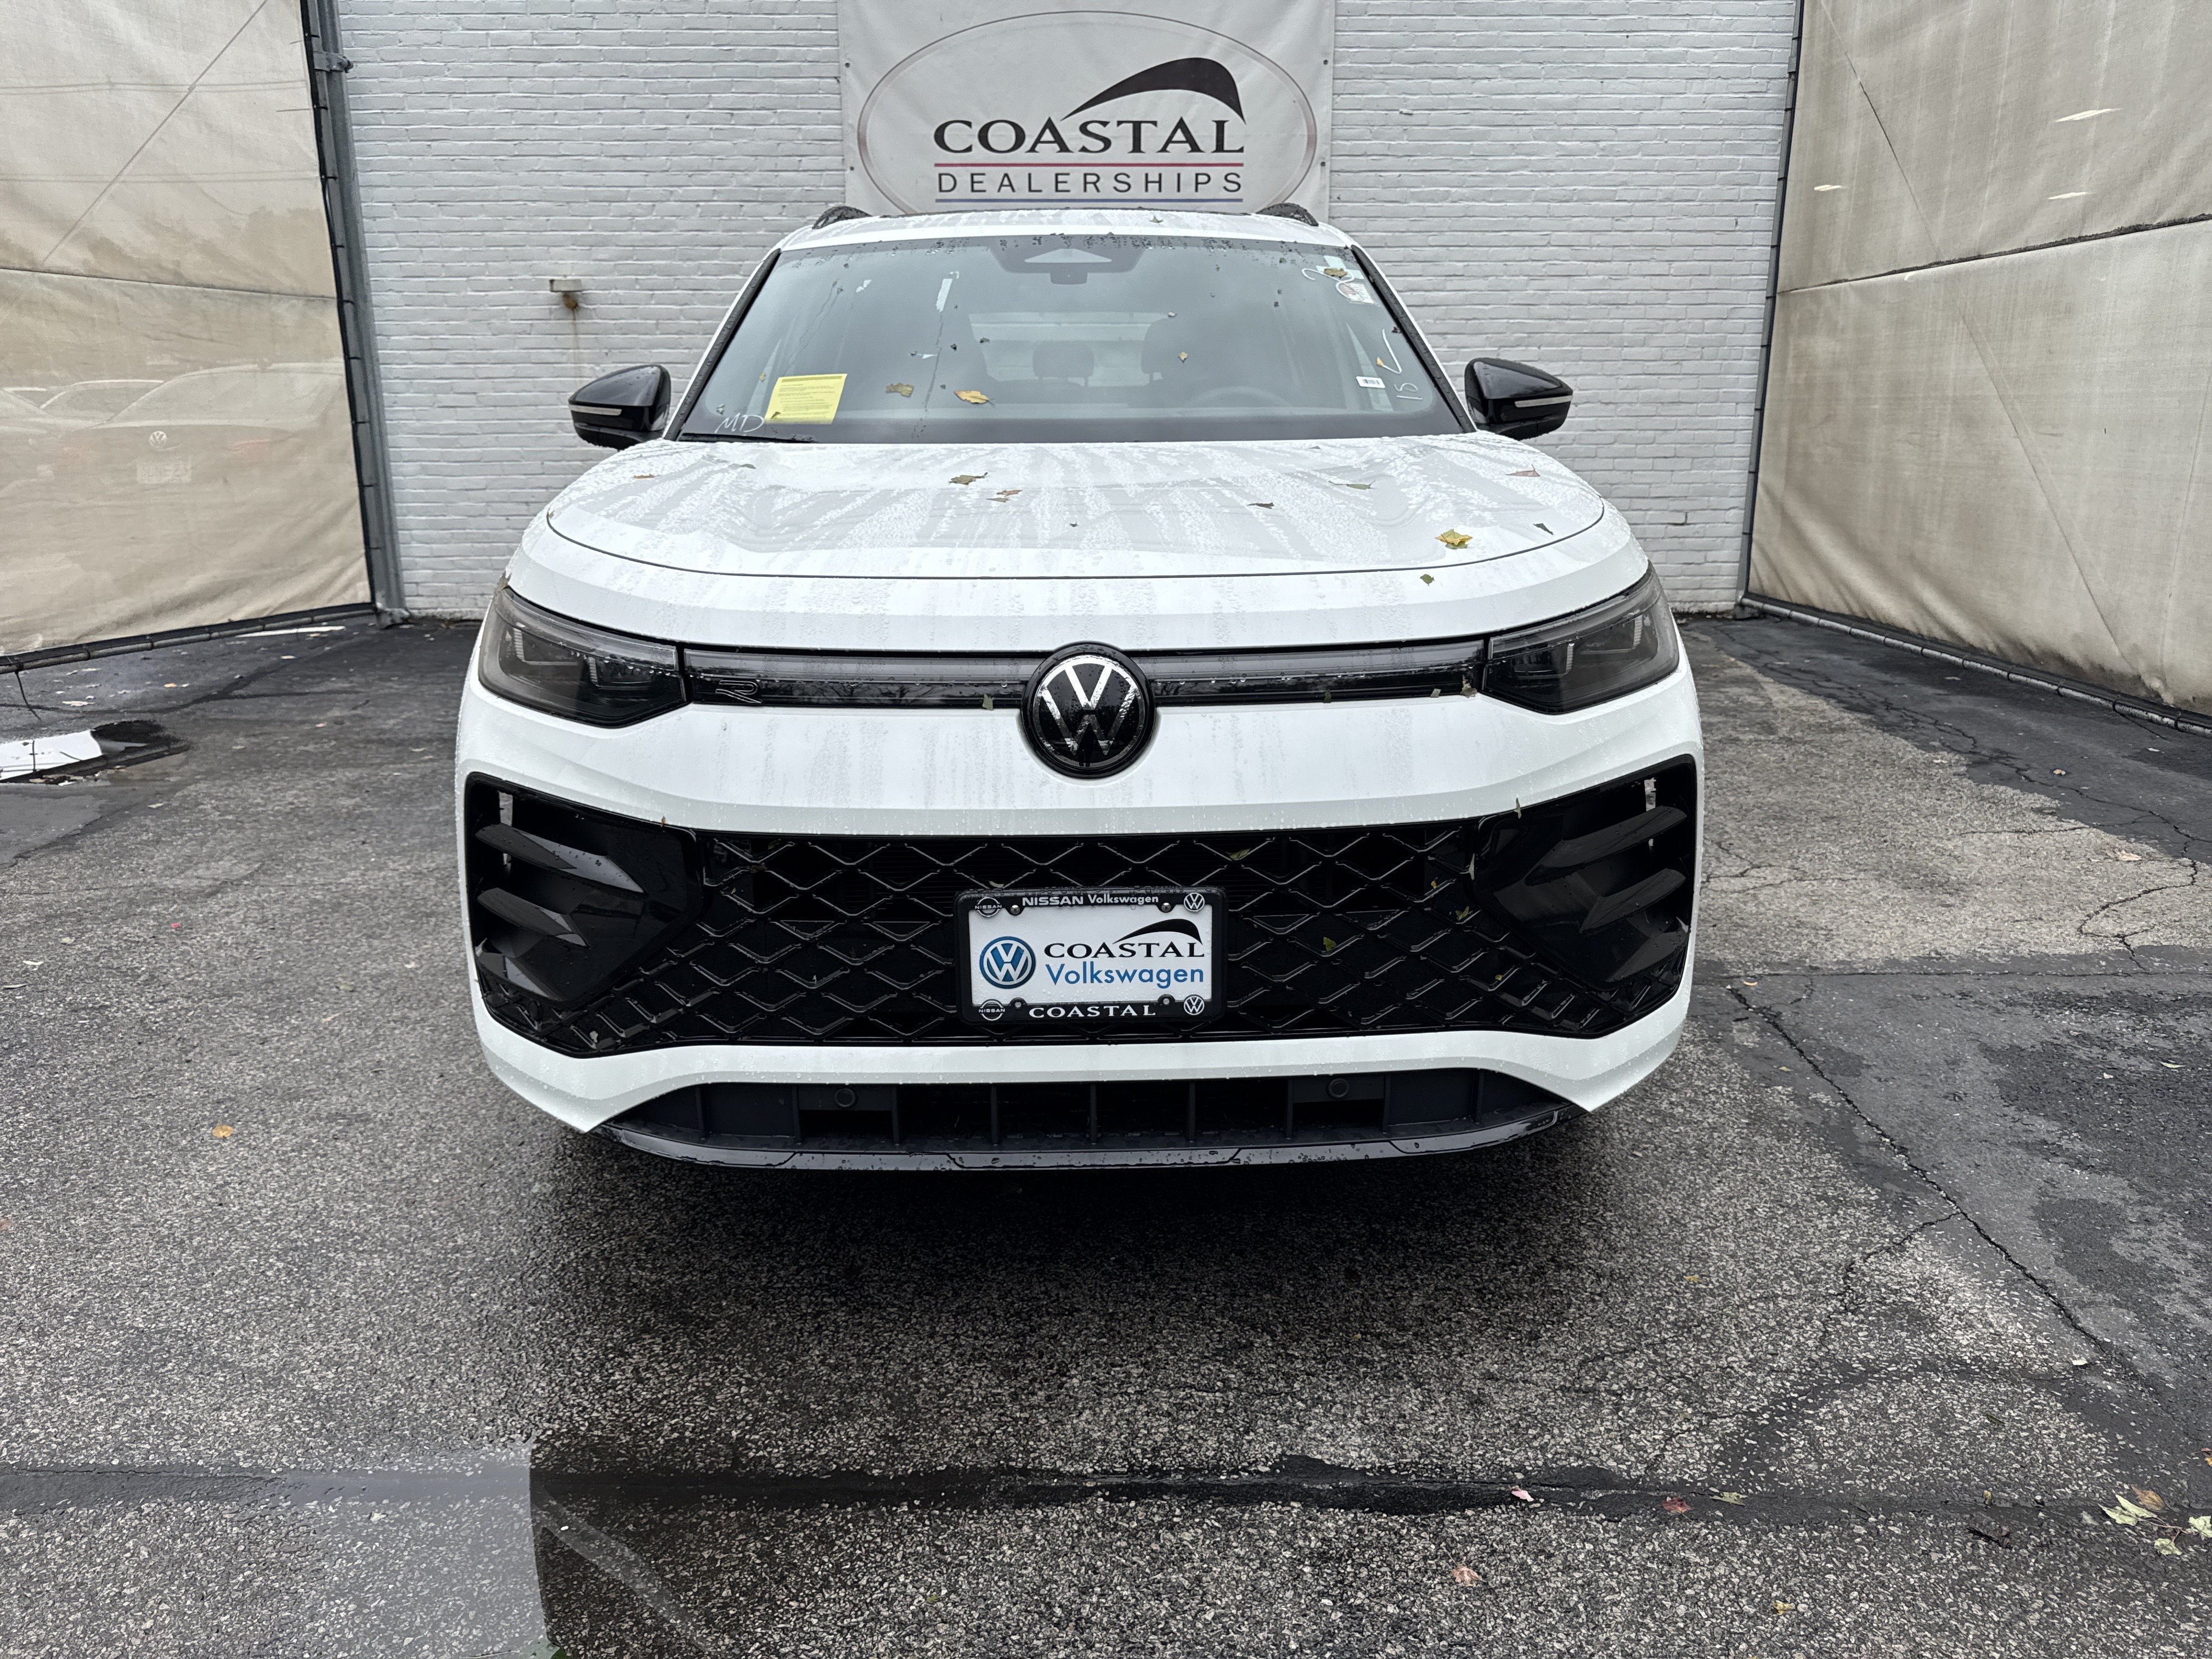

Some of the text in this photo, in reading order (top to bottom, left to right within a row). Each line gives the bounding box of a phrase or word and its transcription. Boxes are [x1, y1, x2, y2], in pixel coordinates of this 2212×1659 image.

[933, 116, 1244, 154] COASTAL
[938, 172, 1242, 193] DEALERSHIPS
[714, 412, 765, 433] MD
[715, 680, 762, 704] R
[1022, 894, 1159, 906] NISSAN Volkswagen
[1044, 941, 1205, 959] COASTAL
[981, 938, 1035, 987] VW
[1046, 961, 1204, 989] Volkswagen
[1029, 1004, 1156, 1019] COASTAL
